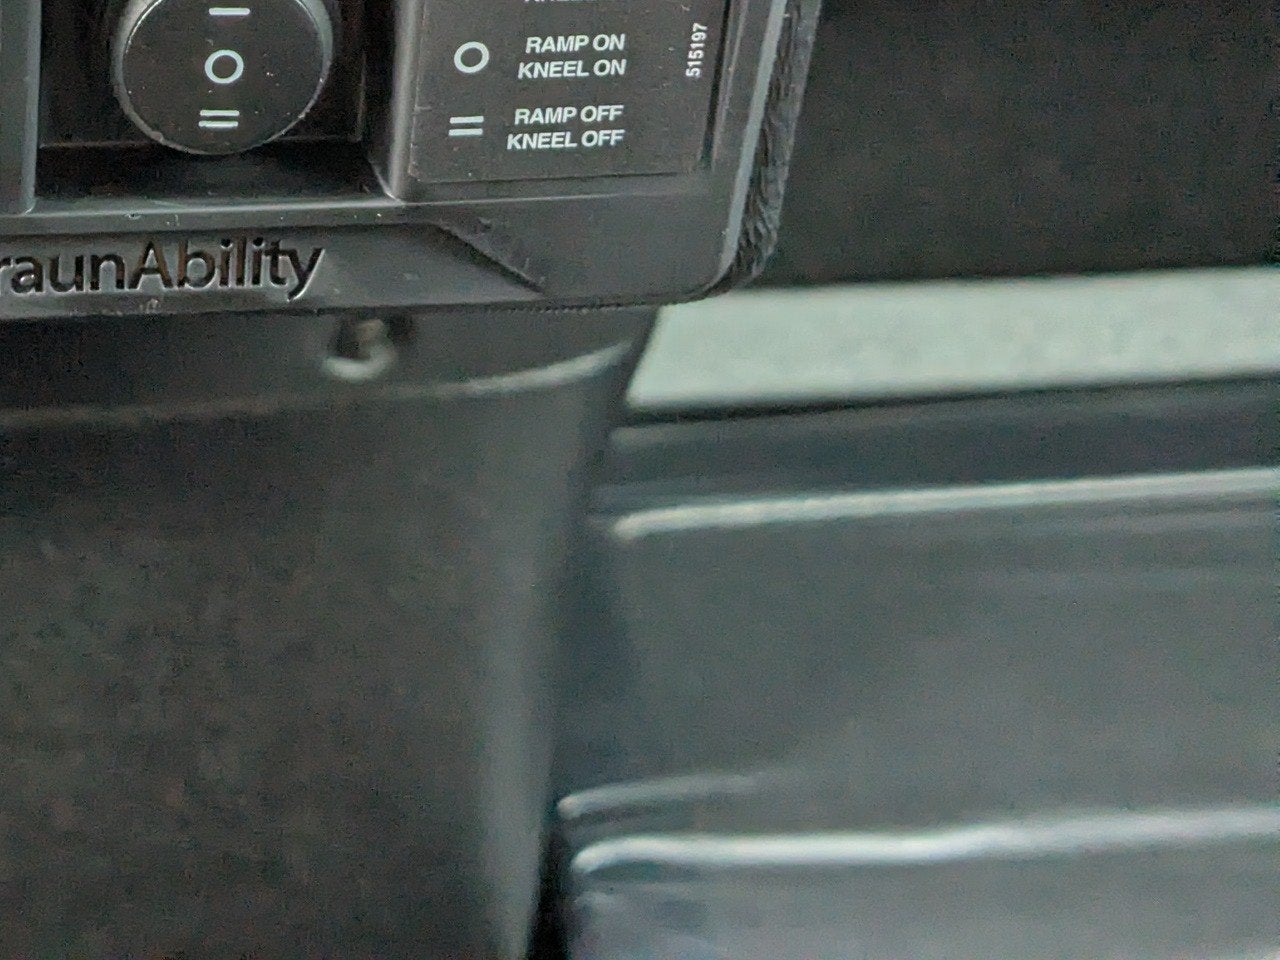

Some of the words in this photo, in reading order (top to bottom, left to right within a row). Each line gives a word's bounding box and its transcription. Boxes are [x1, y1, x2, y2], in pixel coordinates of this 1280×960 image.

[525, 36, 589, 54] RAMP
[593, 34, 626, 51] ON
[685, 22, 708, 79] 515197
[518, 61, 589, 79] KNEEL
[593, 59, 627, 76] ON
[514, 108, 576, 125] RAMP
[580, 105, 624, 122] OFF
[506, 133, 578, 150] KNEEL
[581, 130, 625, 147] OFF
